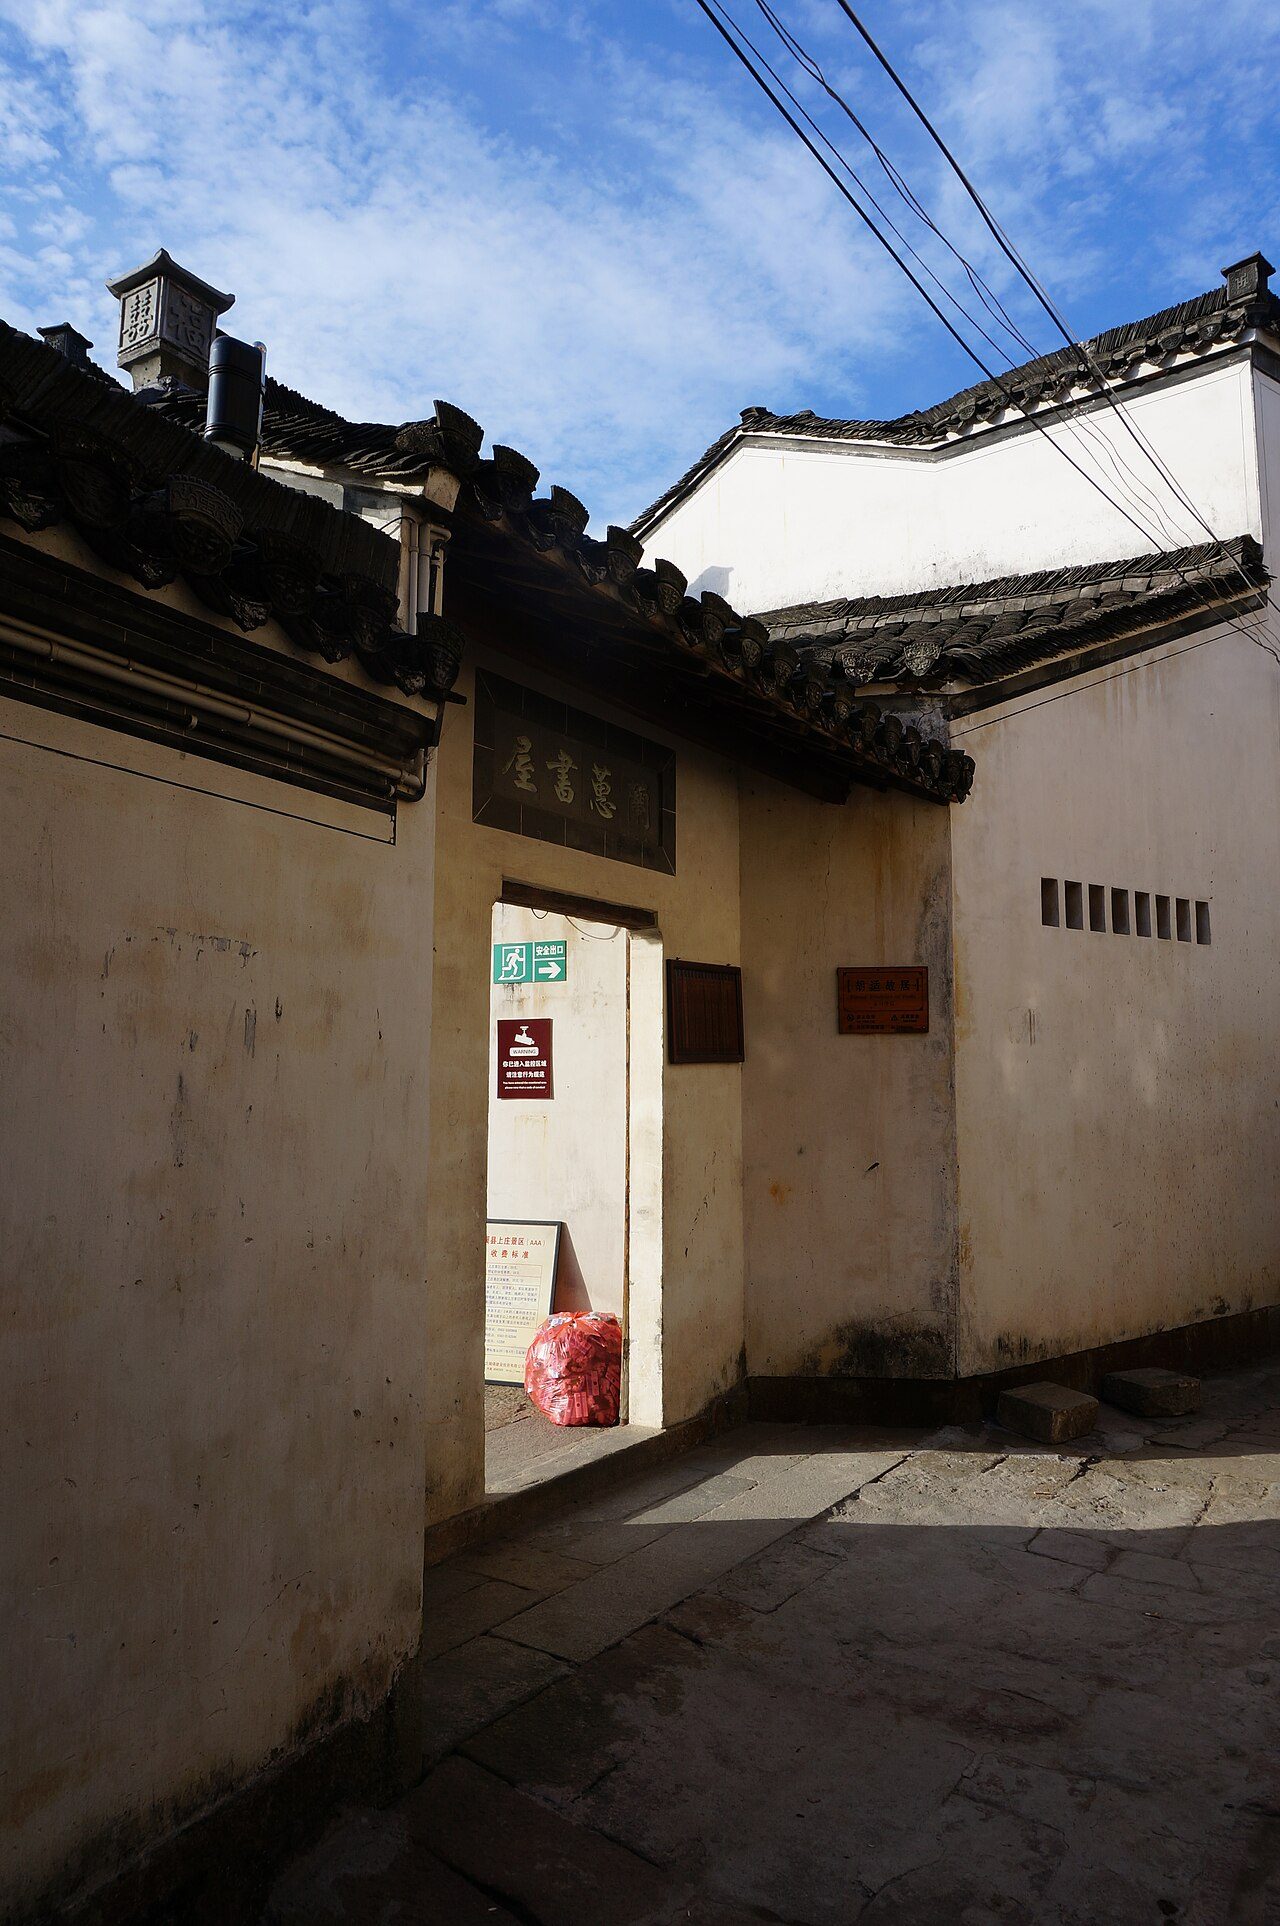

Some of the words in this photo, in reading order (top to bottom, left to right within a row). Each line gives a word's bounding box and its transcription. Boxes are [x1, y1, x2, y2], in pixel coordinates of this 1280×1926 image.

[536, 944, 563, 956] 安全出口
[490, 1249, 529, 1259] 收费标准
